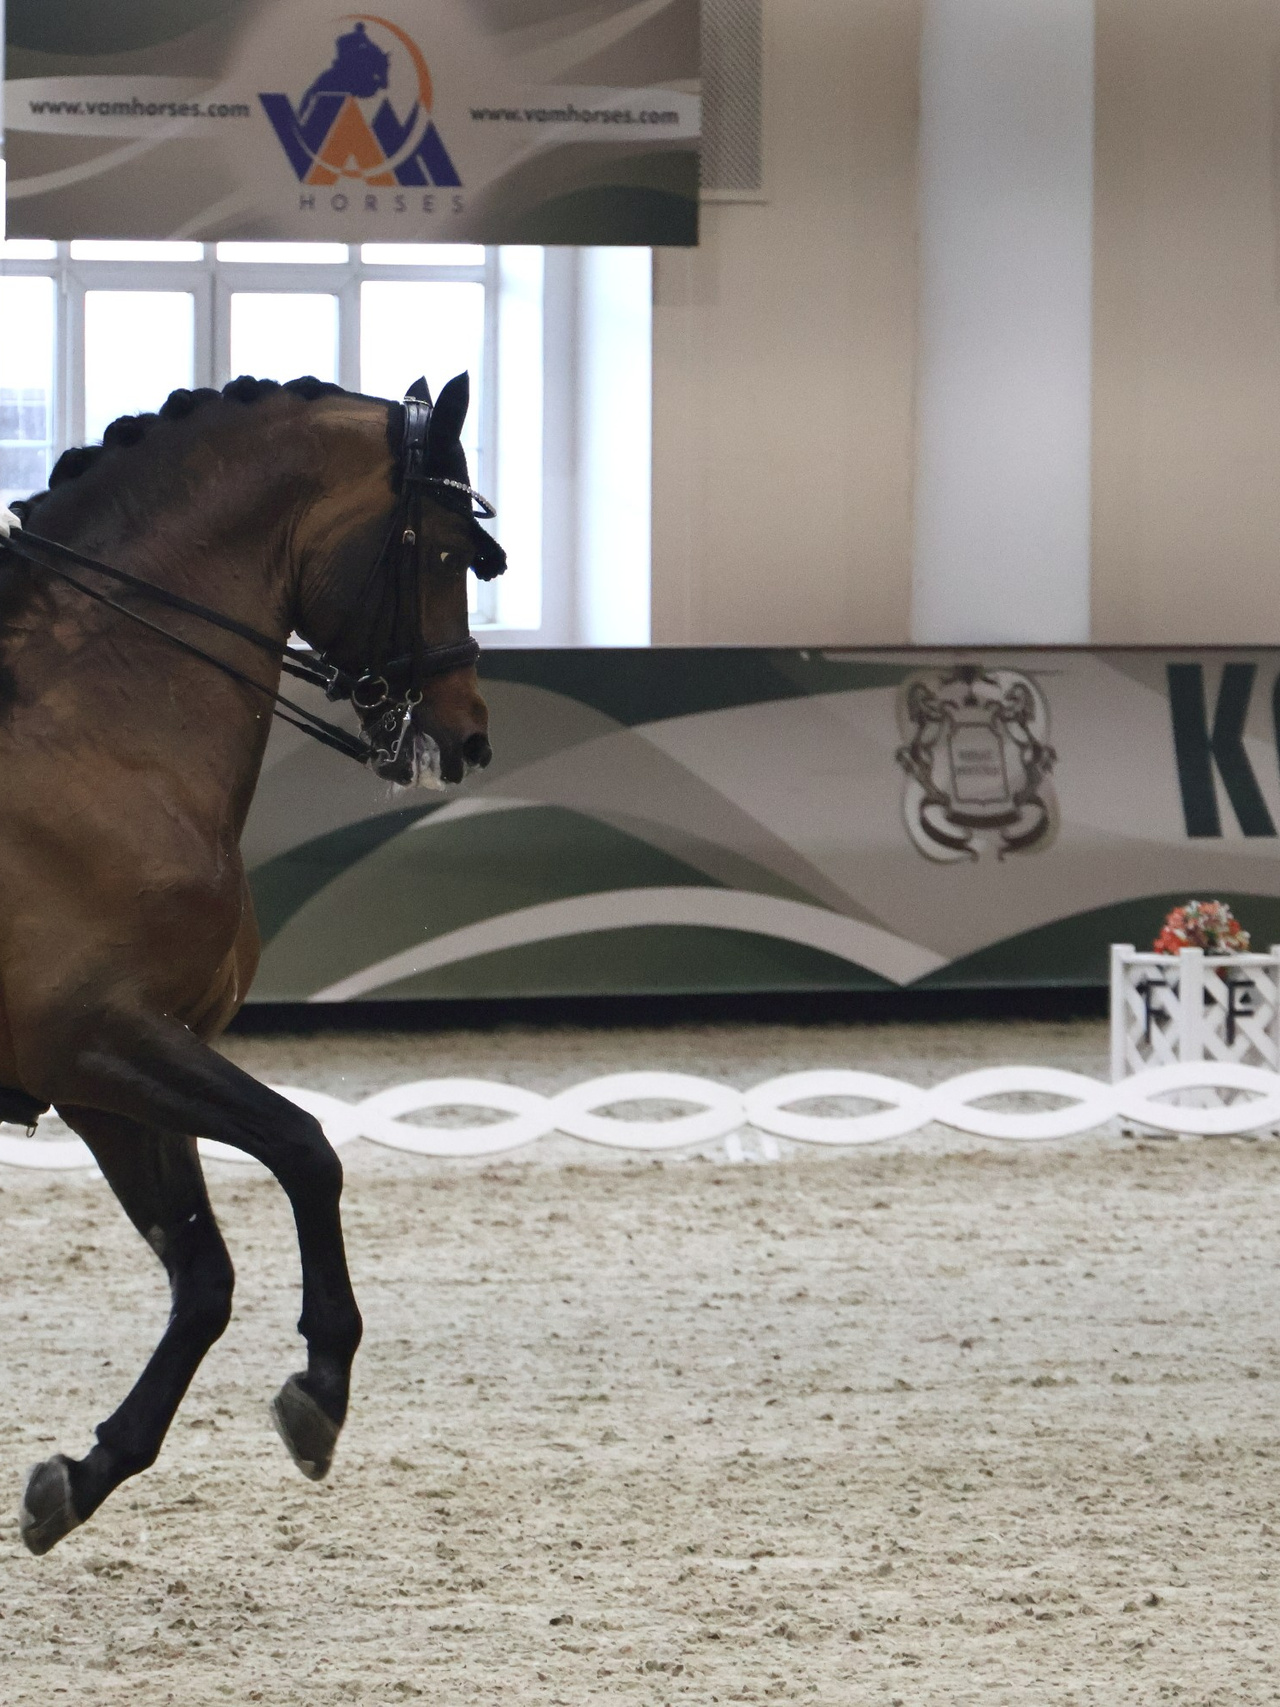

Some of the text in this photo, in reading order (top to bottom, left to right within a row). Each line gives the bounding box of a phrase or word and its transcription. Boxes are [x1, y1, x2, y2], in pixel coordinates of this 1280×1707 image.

[29, 97, 251, 117] www.vamhorses.com
[469, 103, 680, 124] www.vamhorses.com
[299, 194, 464, 213] HORSES
[1166, 662, 1280, 838] K
[1226, 980, 1255, 1045] F
